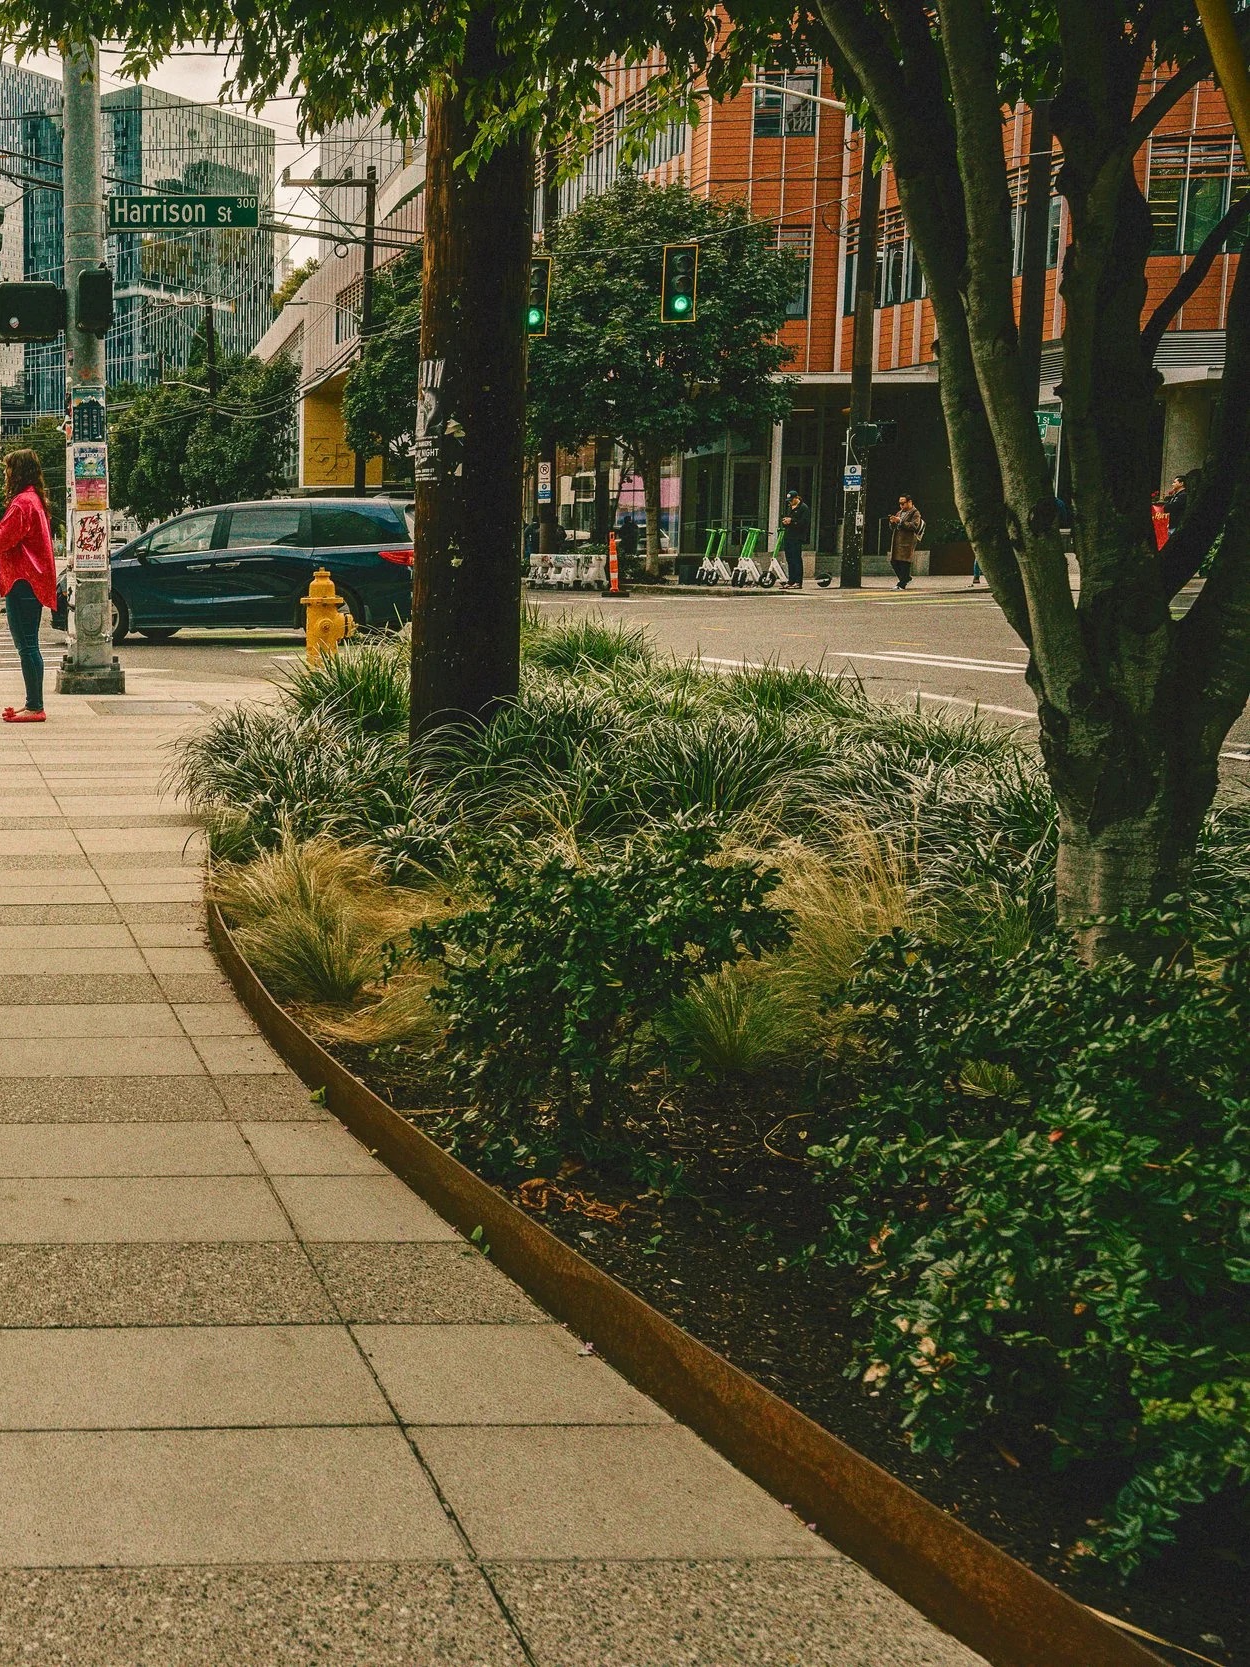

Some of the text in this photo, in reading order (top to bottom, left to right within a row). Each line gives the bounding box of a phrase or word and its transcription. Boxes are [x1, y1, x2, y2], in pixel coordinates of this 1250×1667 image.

[114, 197, 256, 223] Harrison St 300
